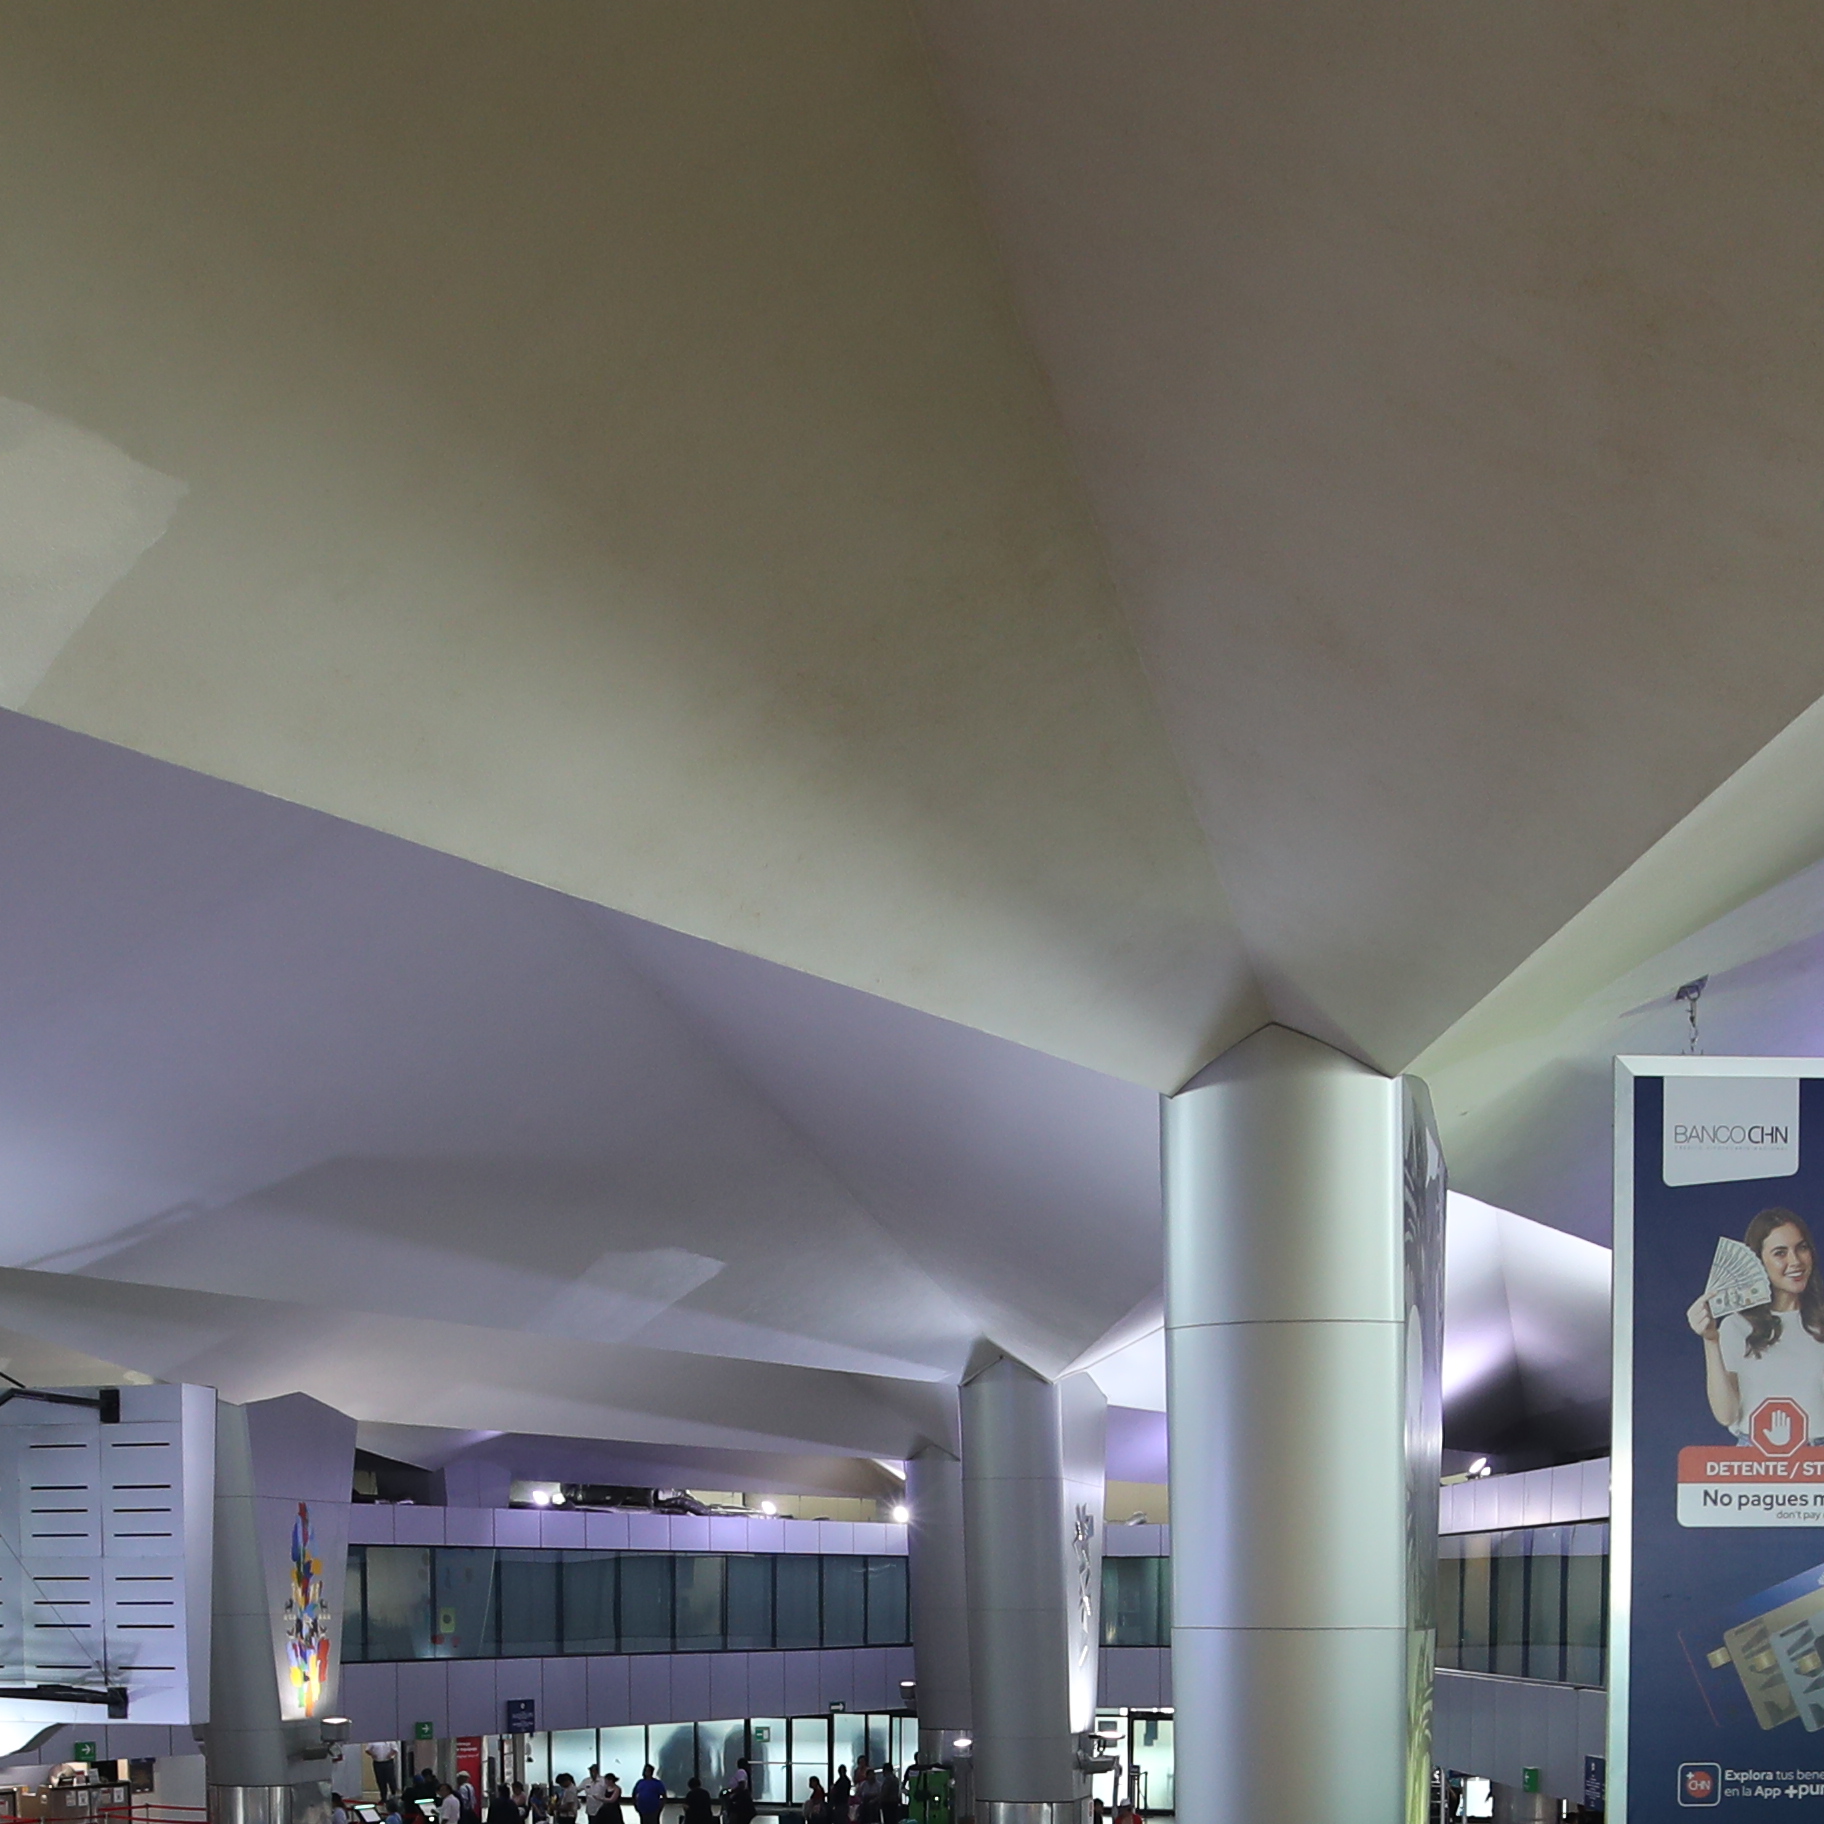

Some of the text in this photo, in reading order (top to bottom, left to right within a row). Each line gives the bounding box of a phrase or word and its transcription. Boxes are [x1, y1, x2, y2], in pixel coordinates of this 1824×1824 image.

[1705, 1461, 1789, 1477] DETENTE
[1702, 1489, 1733, 1508] No
[1737, 1492, 1810, 1512] pagues
[1776, 1510, 1803, 1520] don't
[1803, 1512, 1823, 1522] pay
[1724, 1768, 1775, 1784] Explora
[1775, 1769, 1795, 1781] tus
[1724, 1787, 1741, 1798] en
[1741, 1785, 1753, 1797] la
[1753, 1785, 1782, 1800] App
